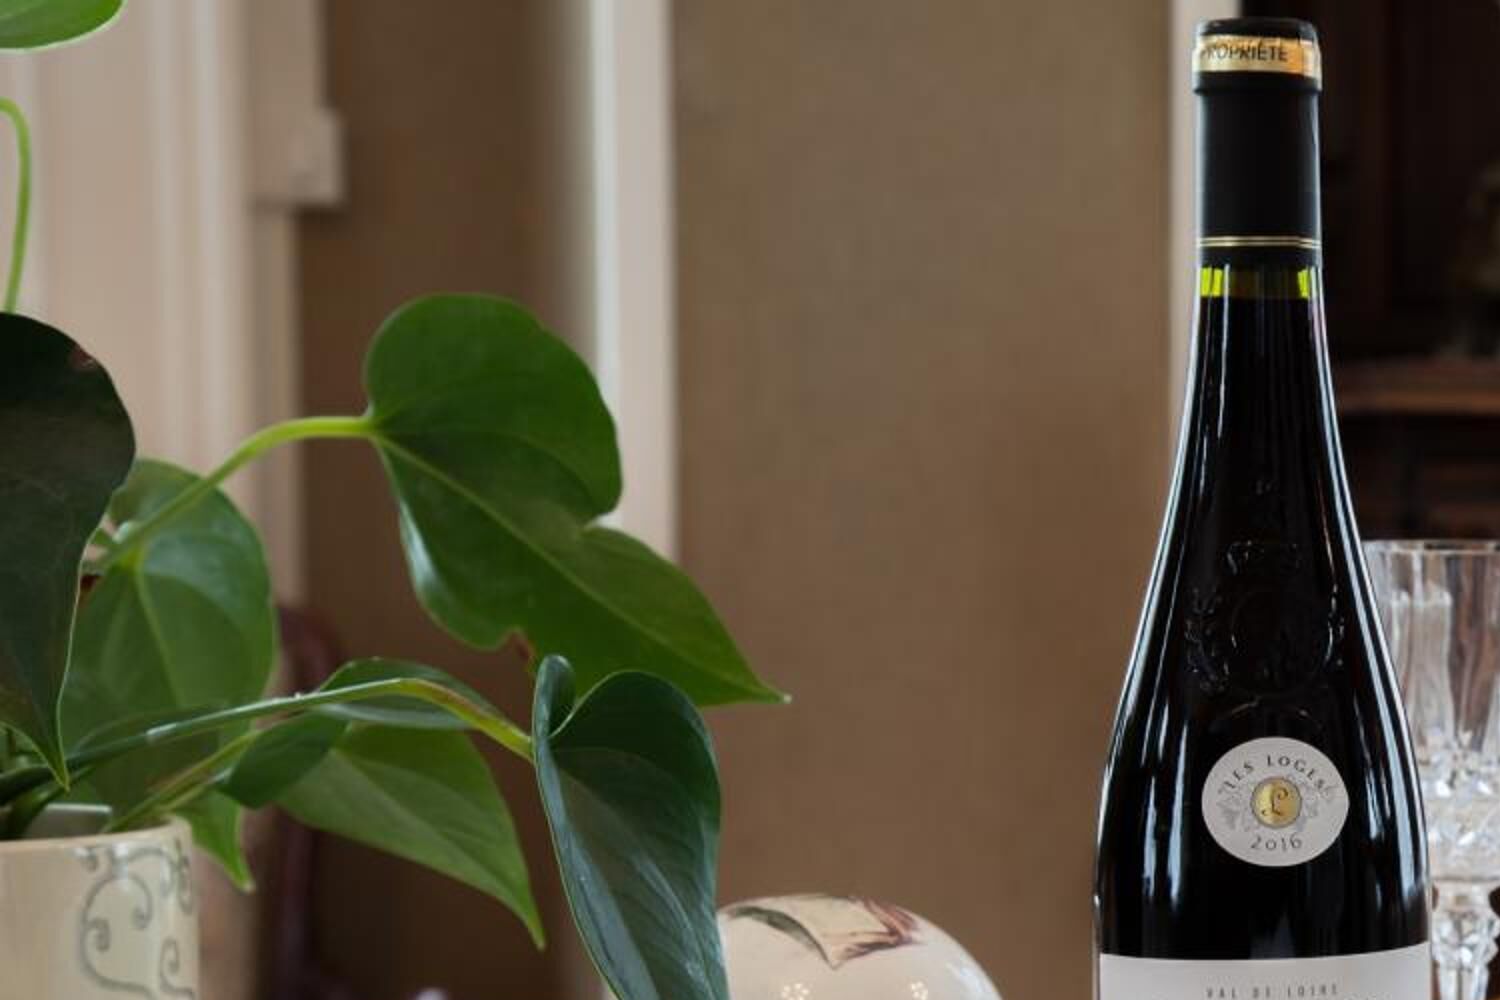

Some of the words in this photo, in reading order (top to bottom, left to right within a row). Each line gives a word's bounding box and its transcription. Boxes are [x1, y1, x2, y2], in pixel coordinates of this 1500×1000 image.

[1223, 761, 1255, 790] LES
[1266, 755, 1326, 790] LOGES
[1250, 832, 1302, 852] 2016
